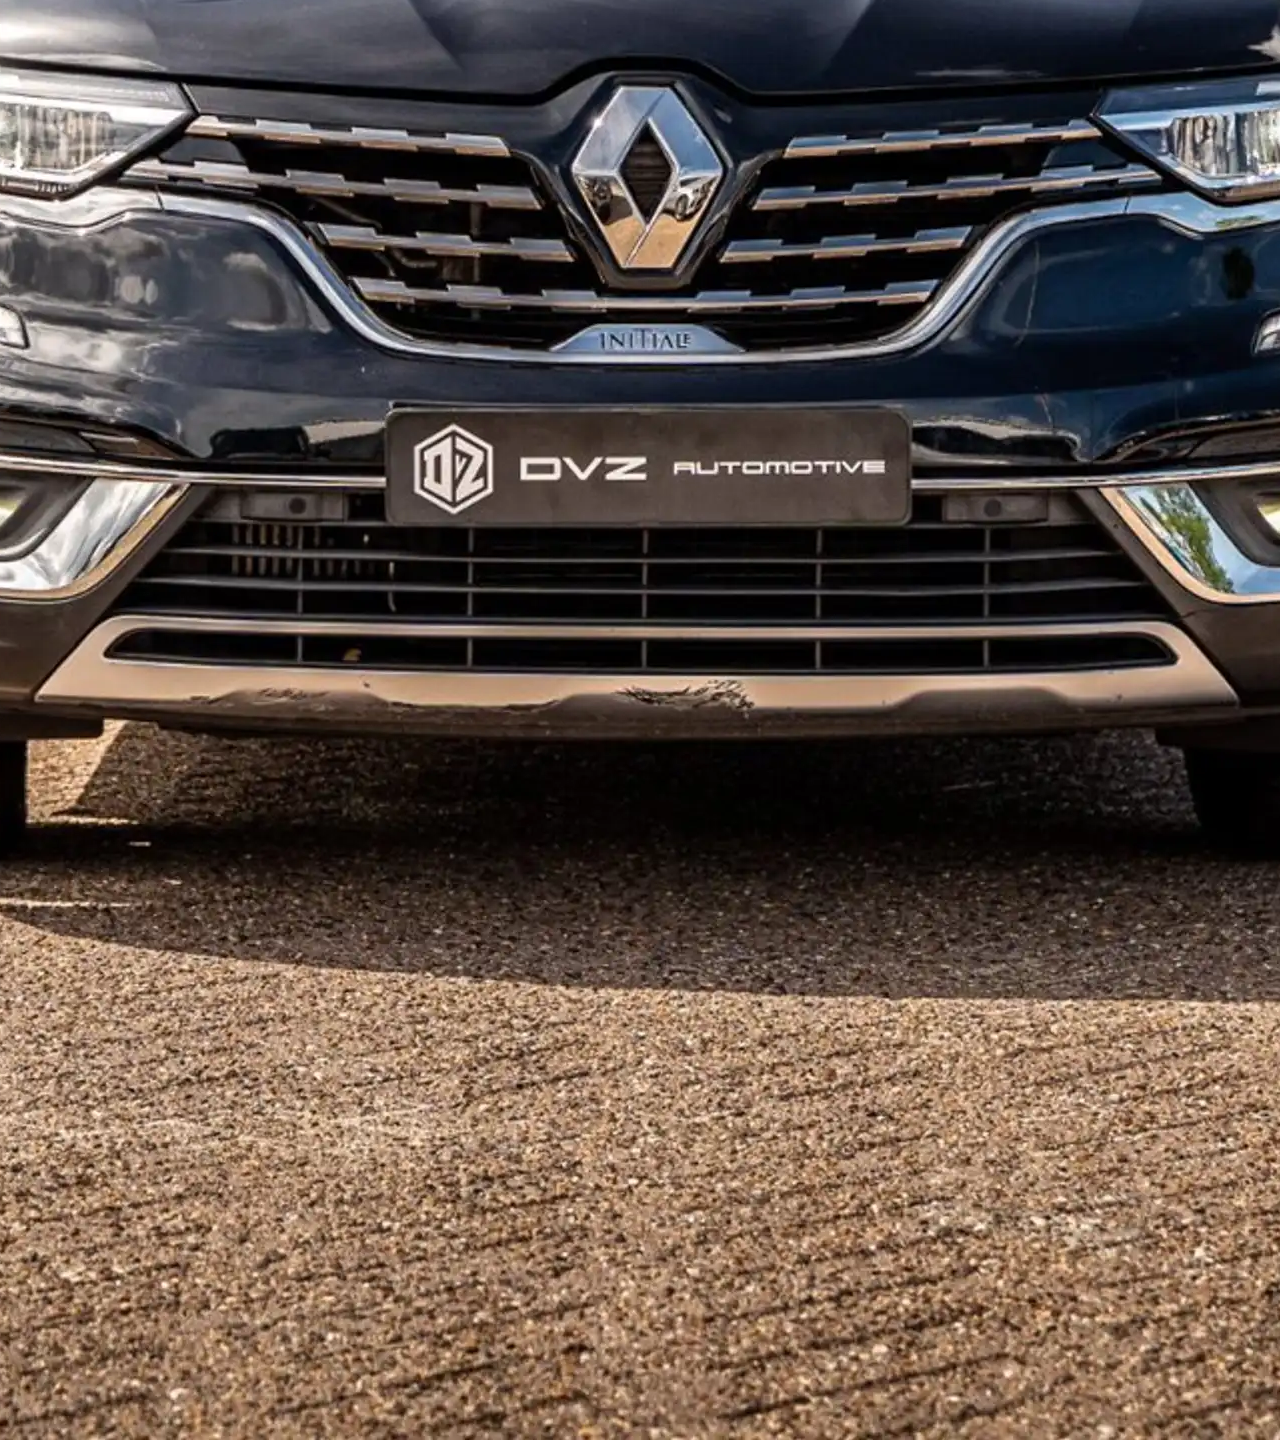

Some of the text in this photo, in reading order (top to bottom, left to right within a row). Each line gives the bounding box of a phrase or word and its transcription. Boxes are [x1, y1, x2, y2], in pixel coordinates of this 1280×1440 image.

[600, 327, 691, 350] INITIALE
[520, 456, 647, 481] DVZ
[673, 460, 886, 475] AUTOMOTIVE
